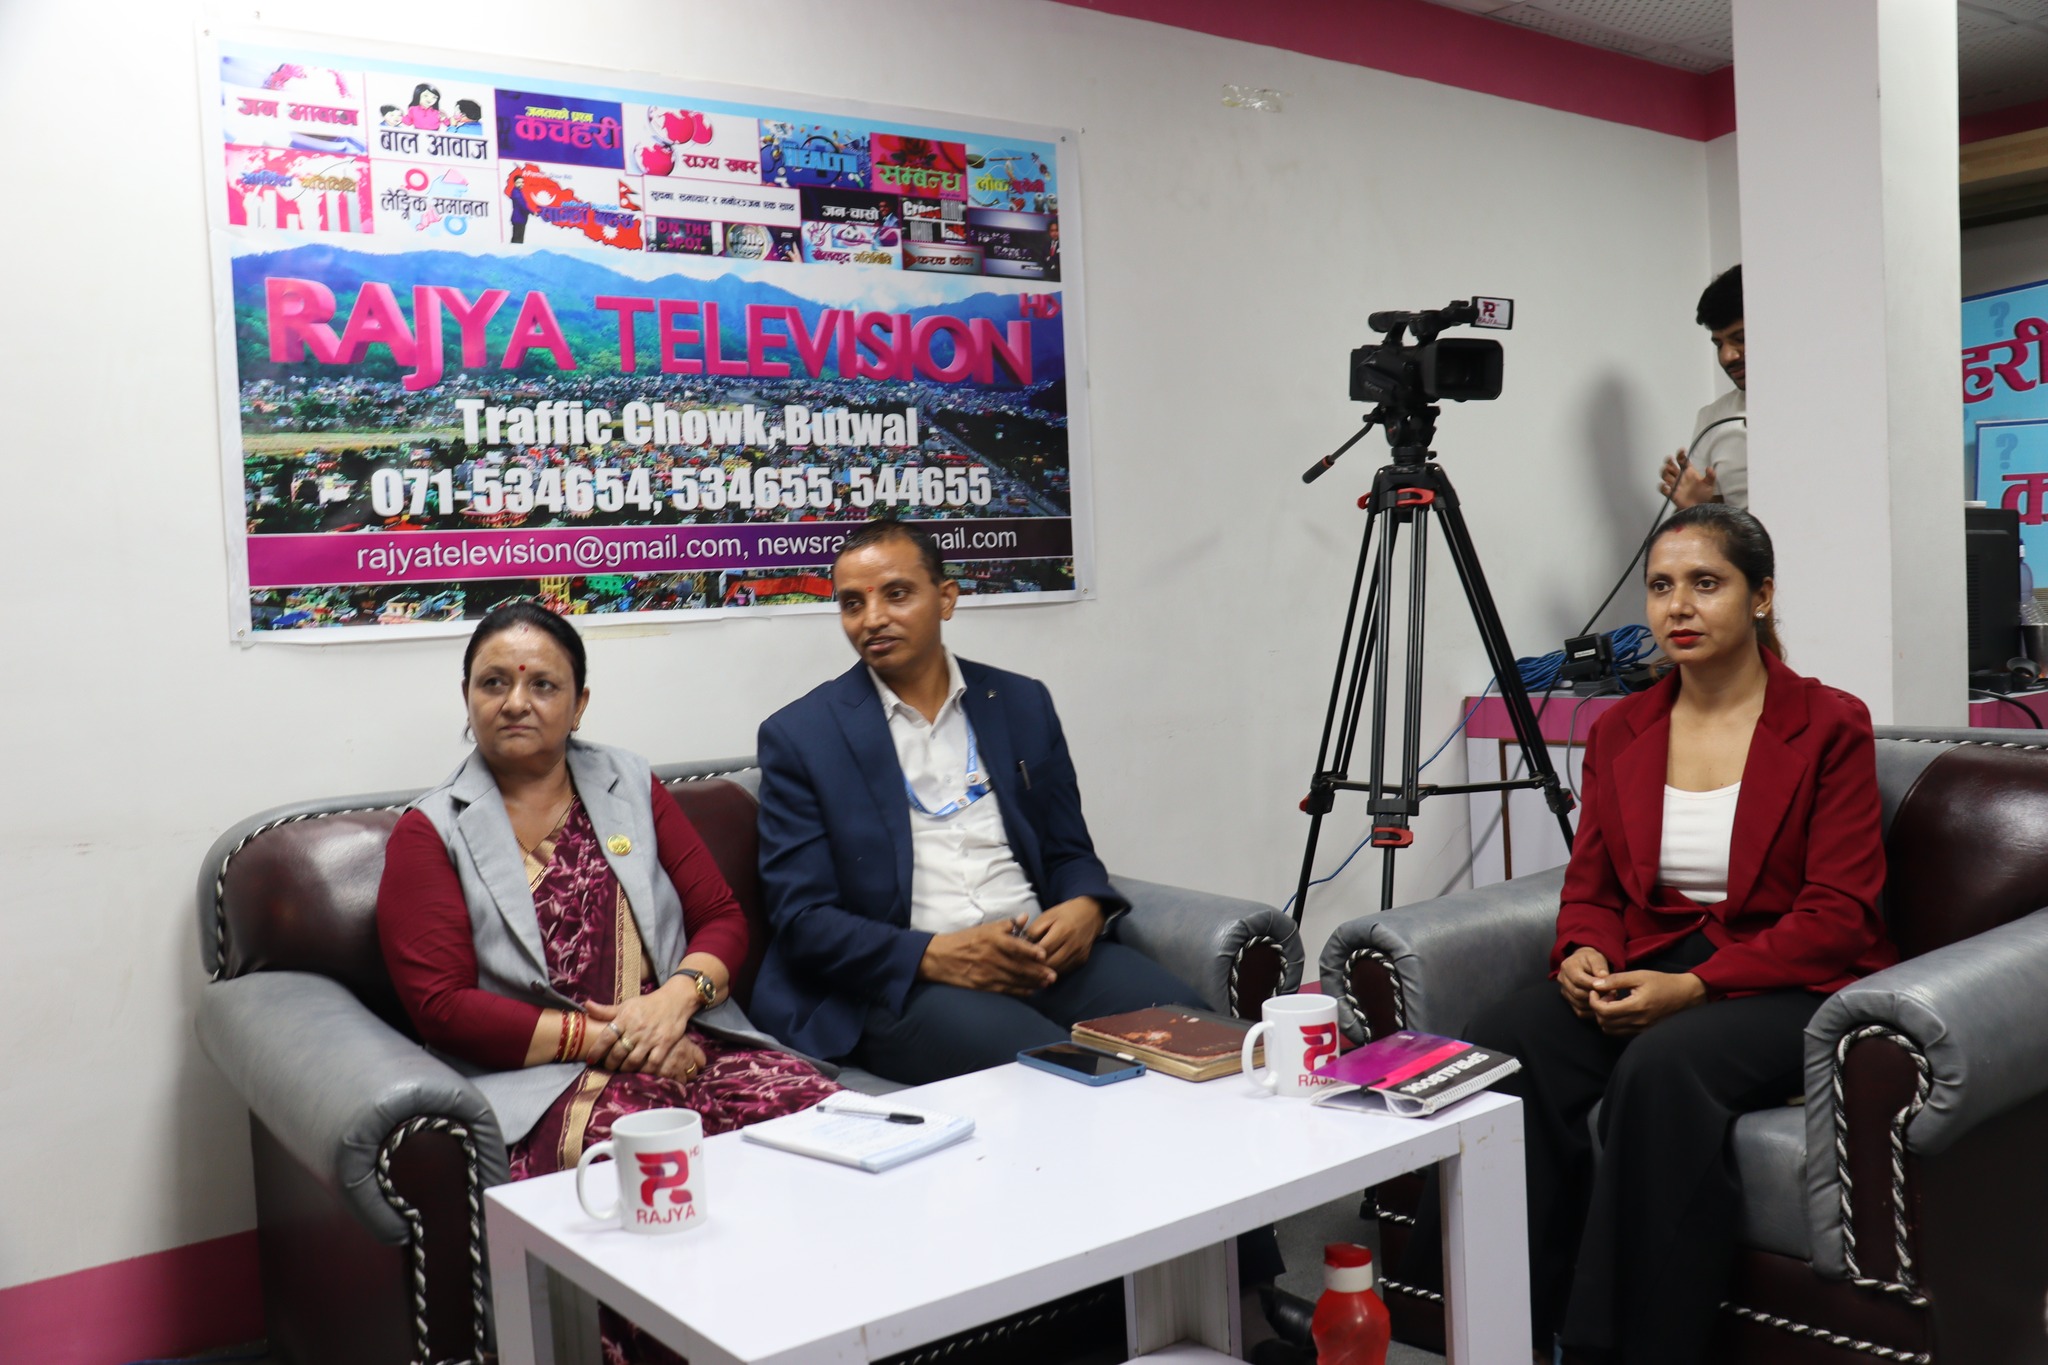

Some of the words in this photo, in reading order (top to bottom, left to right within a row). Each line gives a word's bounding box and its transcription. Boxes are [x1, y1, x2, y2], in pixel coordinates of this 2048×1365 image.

[380, 130, 419, 154] बाल
[427, 134, 488, 160] आवाज
[514, 115, 622, 149] कचहरी
[682, 153, 720, 169] राज्य
[876, 163, 963, 192] सम्बन्ध
[433, 197, 489, 217] समानता
[658, 221, 680, 234] ON
[685, 223, 711, 236] THE
[667, 236, 703, 250] SPOT
[265, 277, 577, 391] RAJYA
[595, 295, 1032, 385] TELEVISION
[1020, 293, 1060, 319] HD
[456, 398, 613, 447] Traffic
[371, 467, 663, 517] 071-534654,
[671, 465, 842, 513] 534655,
[851, 466, 992, 508] 544655
[357, 533, 749, 576] rajyatelevision@gmail.com,
[636, 1204, 696, 1225] RAJYA
